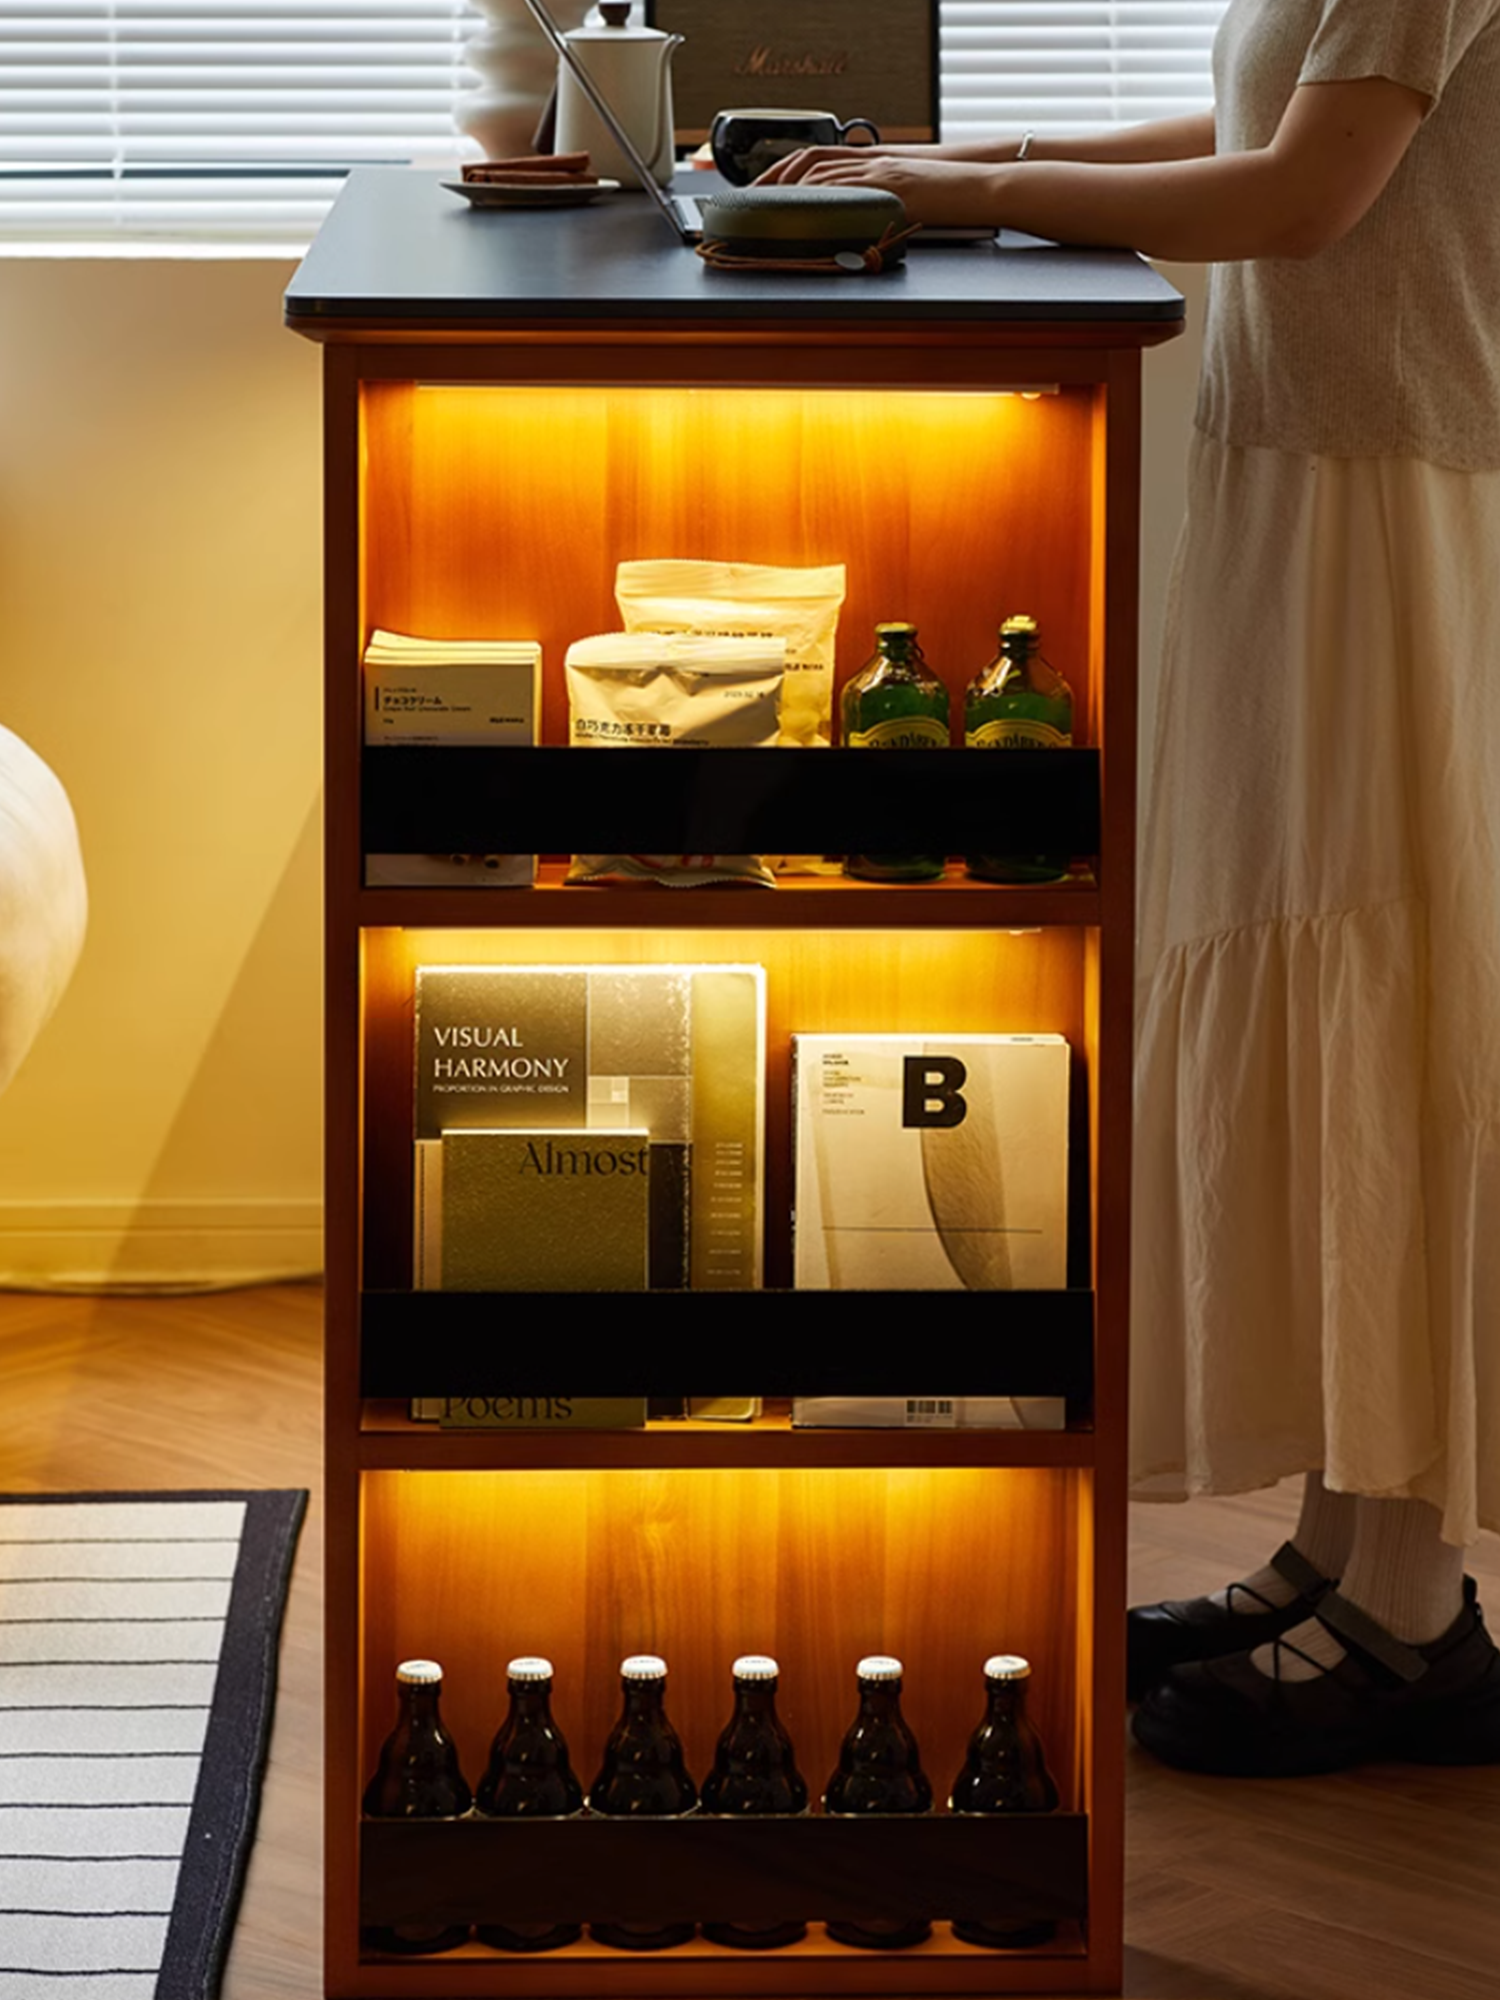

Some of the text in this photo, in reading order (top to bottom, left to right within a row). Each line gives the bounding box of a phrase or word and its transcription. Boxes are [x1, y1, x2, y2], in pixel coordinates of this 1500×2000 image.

[732, 43, 850, 76] Marshall
[433, 1026, 523, 1048] VISUAL
[433, 1057, 570, 1079] HARMONY
[433, 1084, 570, 1094] PROPORTION IN GRAPHIC DESIGN
[902, 1055, 969, 1128] B
[517, 1140, 649, 1176] Almost
[444, 1396, 573, 1420] Poems
